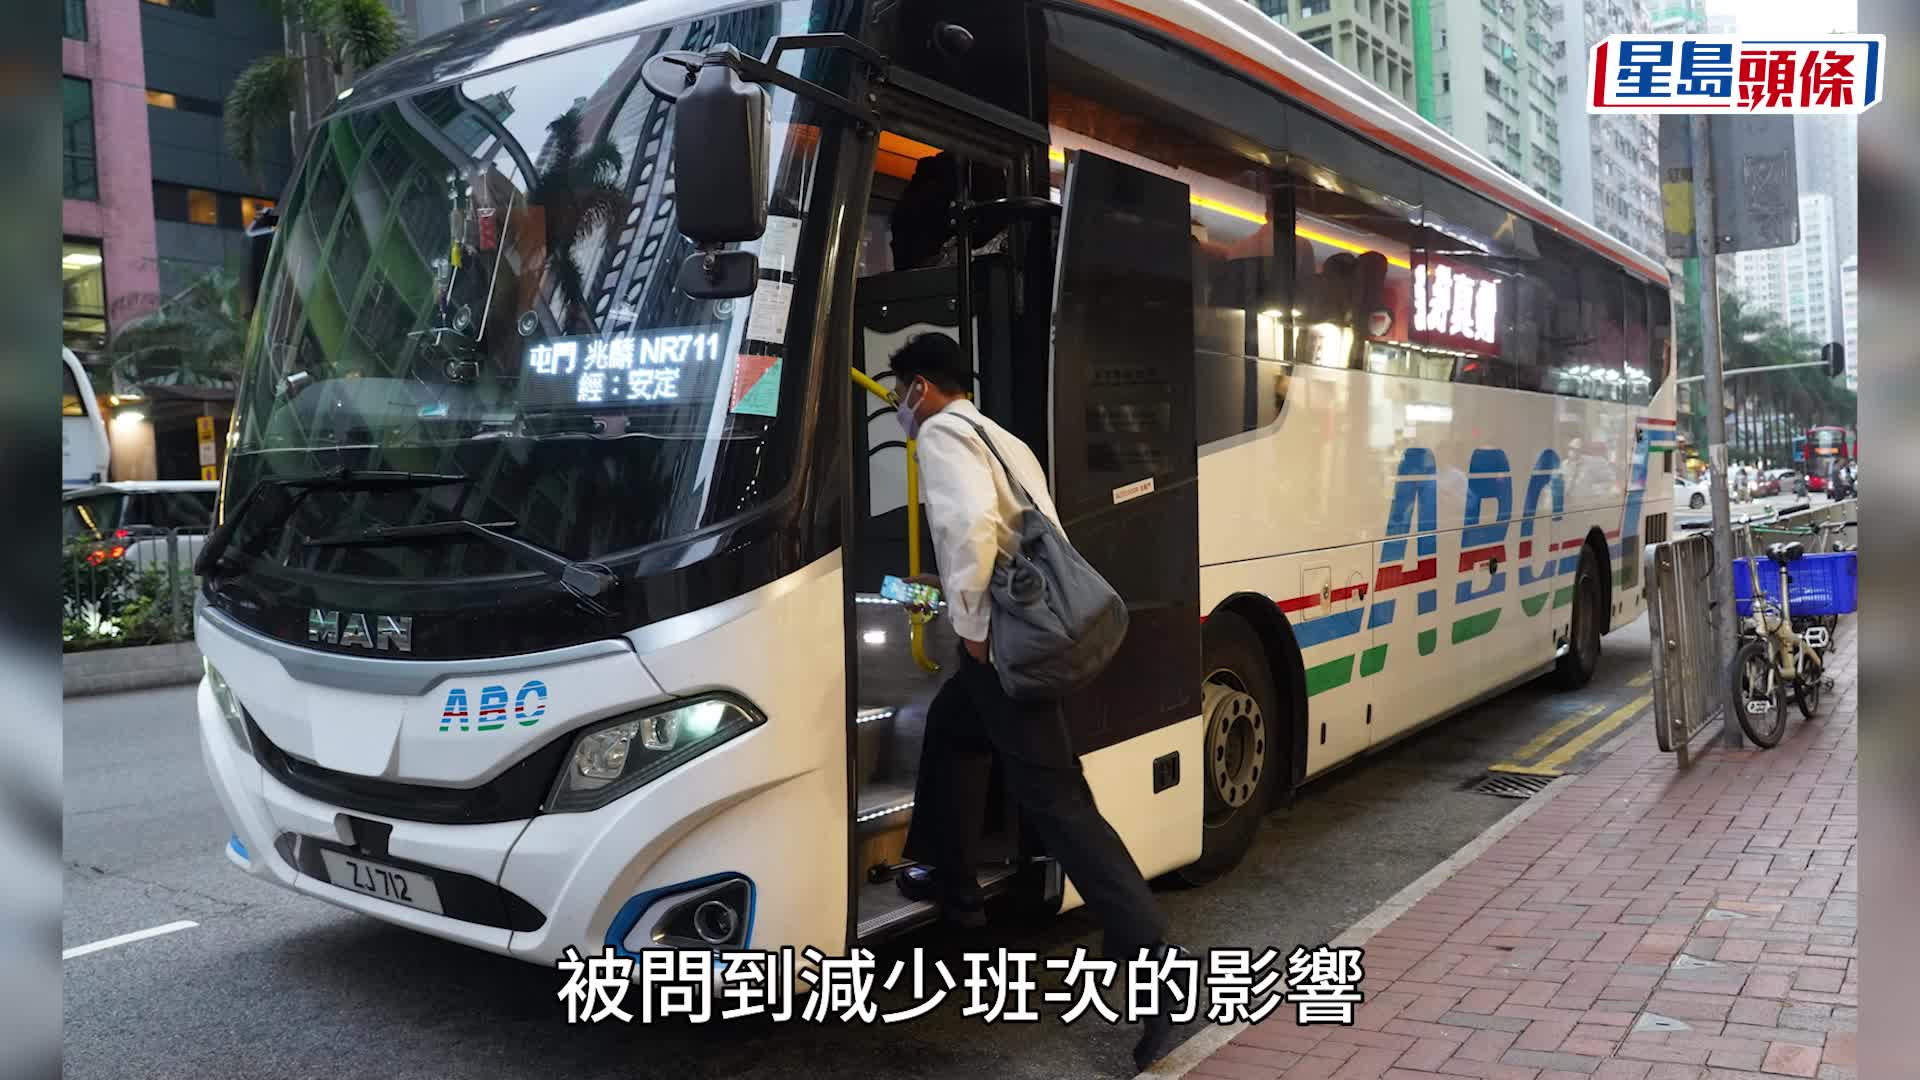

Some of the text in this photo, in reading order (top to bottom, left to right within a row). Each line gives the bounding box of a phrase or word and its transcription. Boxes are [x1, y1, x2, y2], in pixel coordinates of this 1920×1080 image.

[530, 332, 719, 374] 屯門 兆麟 NR711
[1359, 447, 1564, 678] ABC
[308, 608, 412, 651] MAN
[439, 680, 547, 732] ABC
[346, 861, 412, 902] ZJ712
